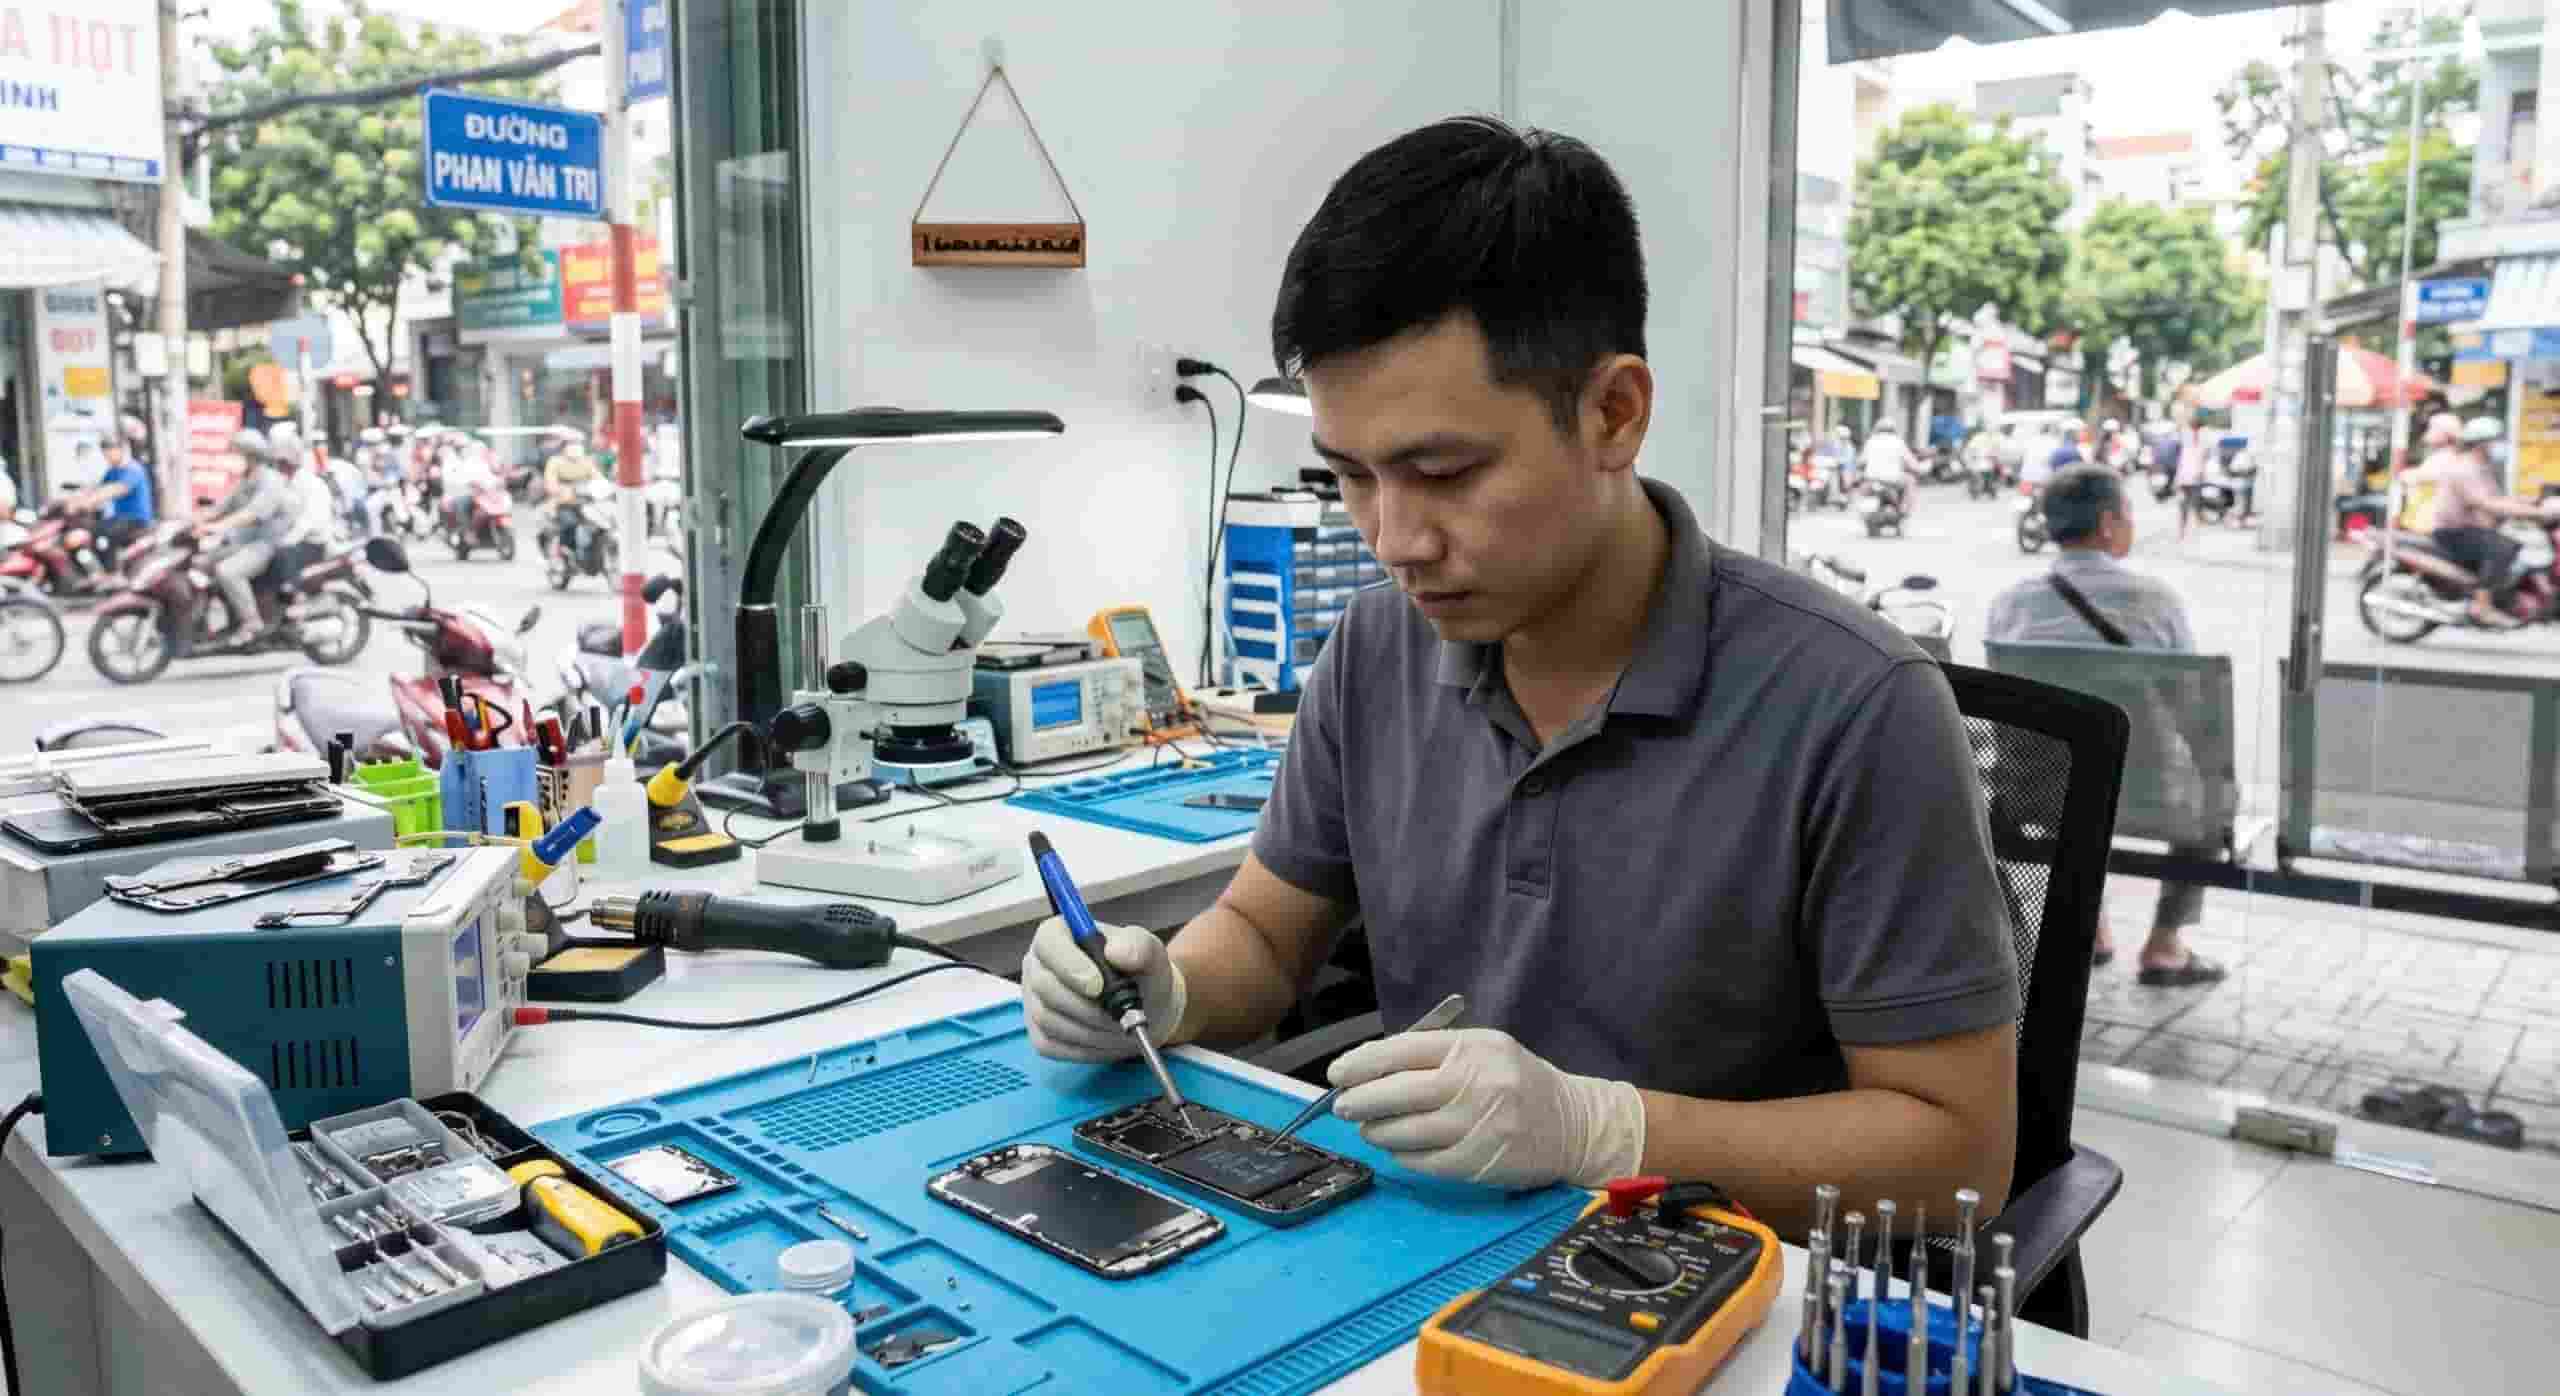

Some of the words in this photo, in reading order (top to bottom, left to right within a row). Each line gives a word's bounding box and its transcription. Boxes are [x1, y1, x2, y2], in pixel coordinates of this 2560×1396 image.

[464, 112, 568, 150] ĐƯỜNG
[434, 150, 502, 193] PHAN
[507, 154, 557, 199] VĂN
[561, 167, 598, 208] TRỊ
